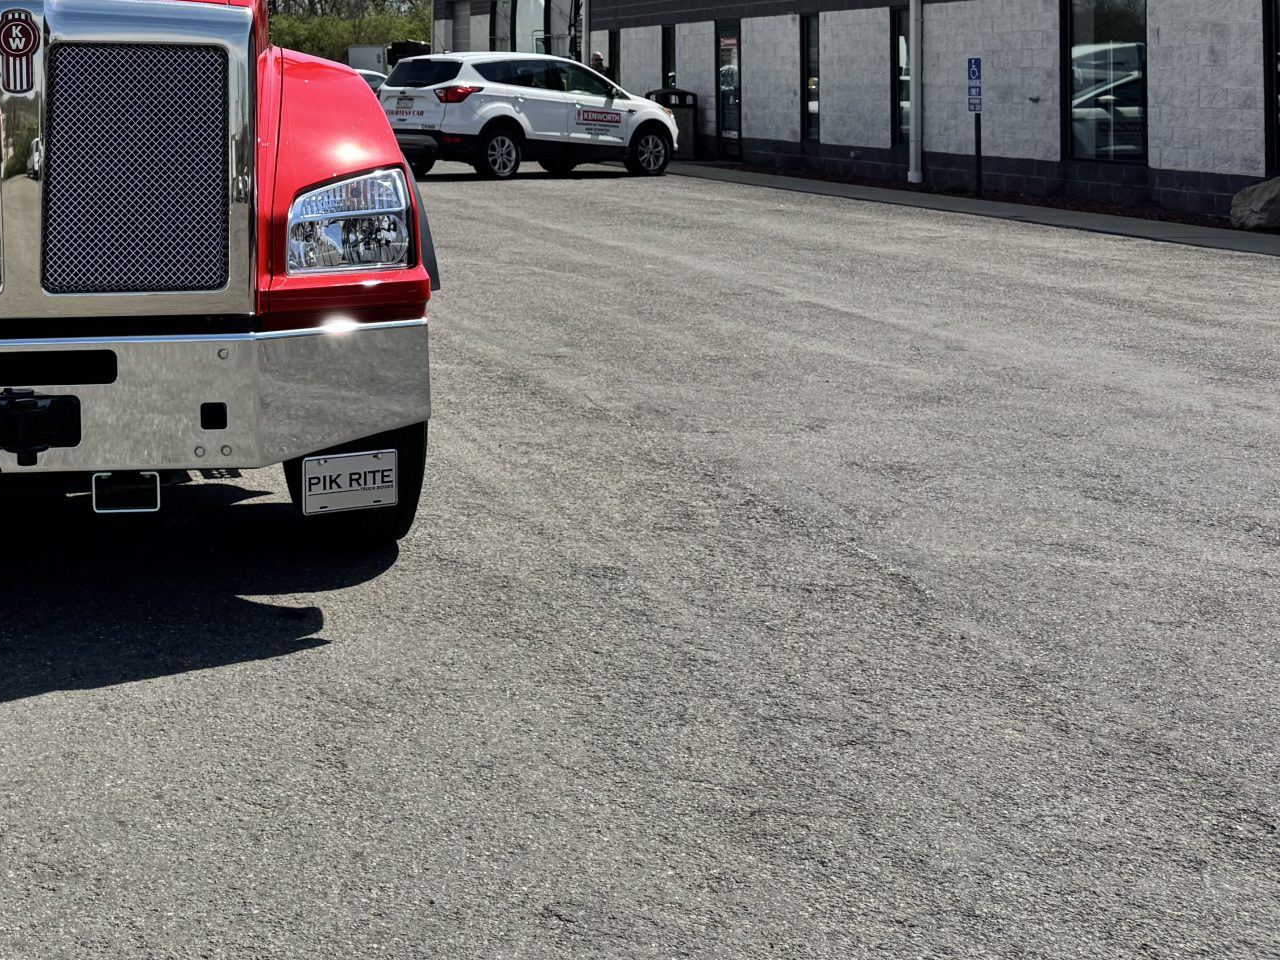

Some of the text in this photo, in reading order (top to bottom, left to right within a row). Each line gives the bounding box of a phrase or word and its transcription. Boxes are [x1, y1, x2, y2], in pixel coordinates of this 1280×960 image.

[583, 111, 620, 122] KENWORTH
[308, 468, 393, 492] PIK RITE
